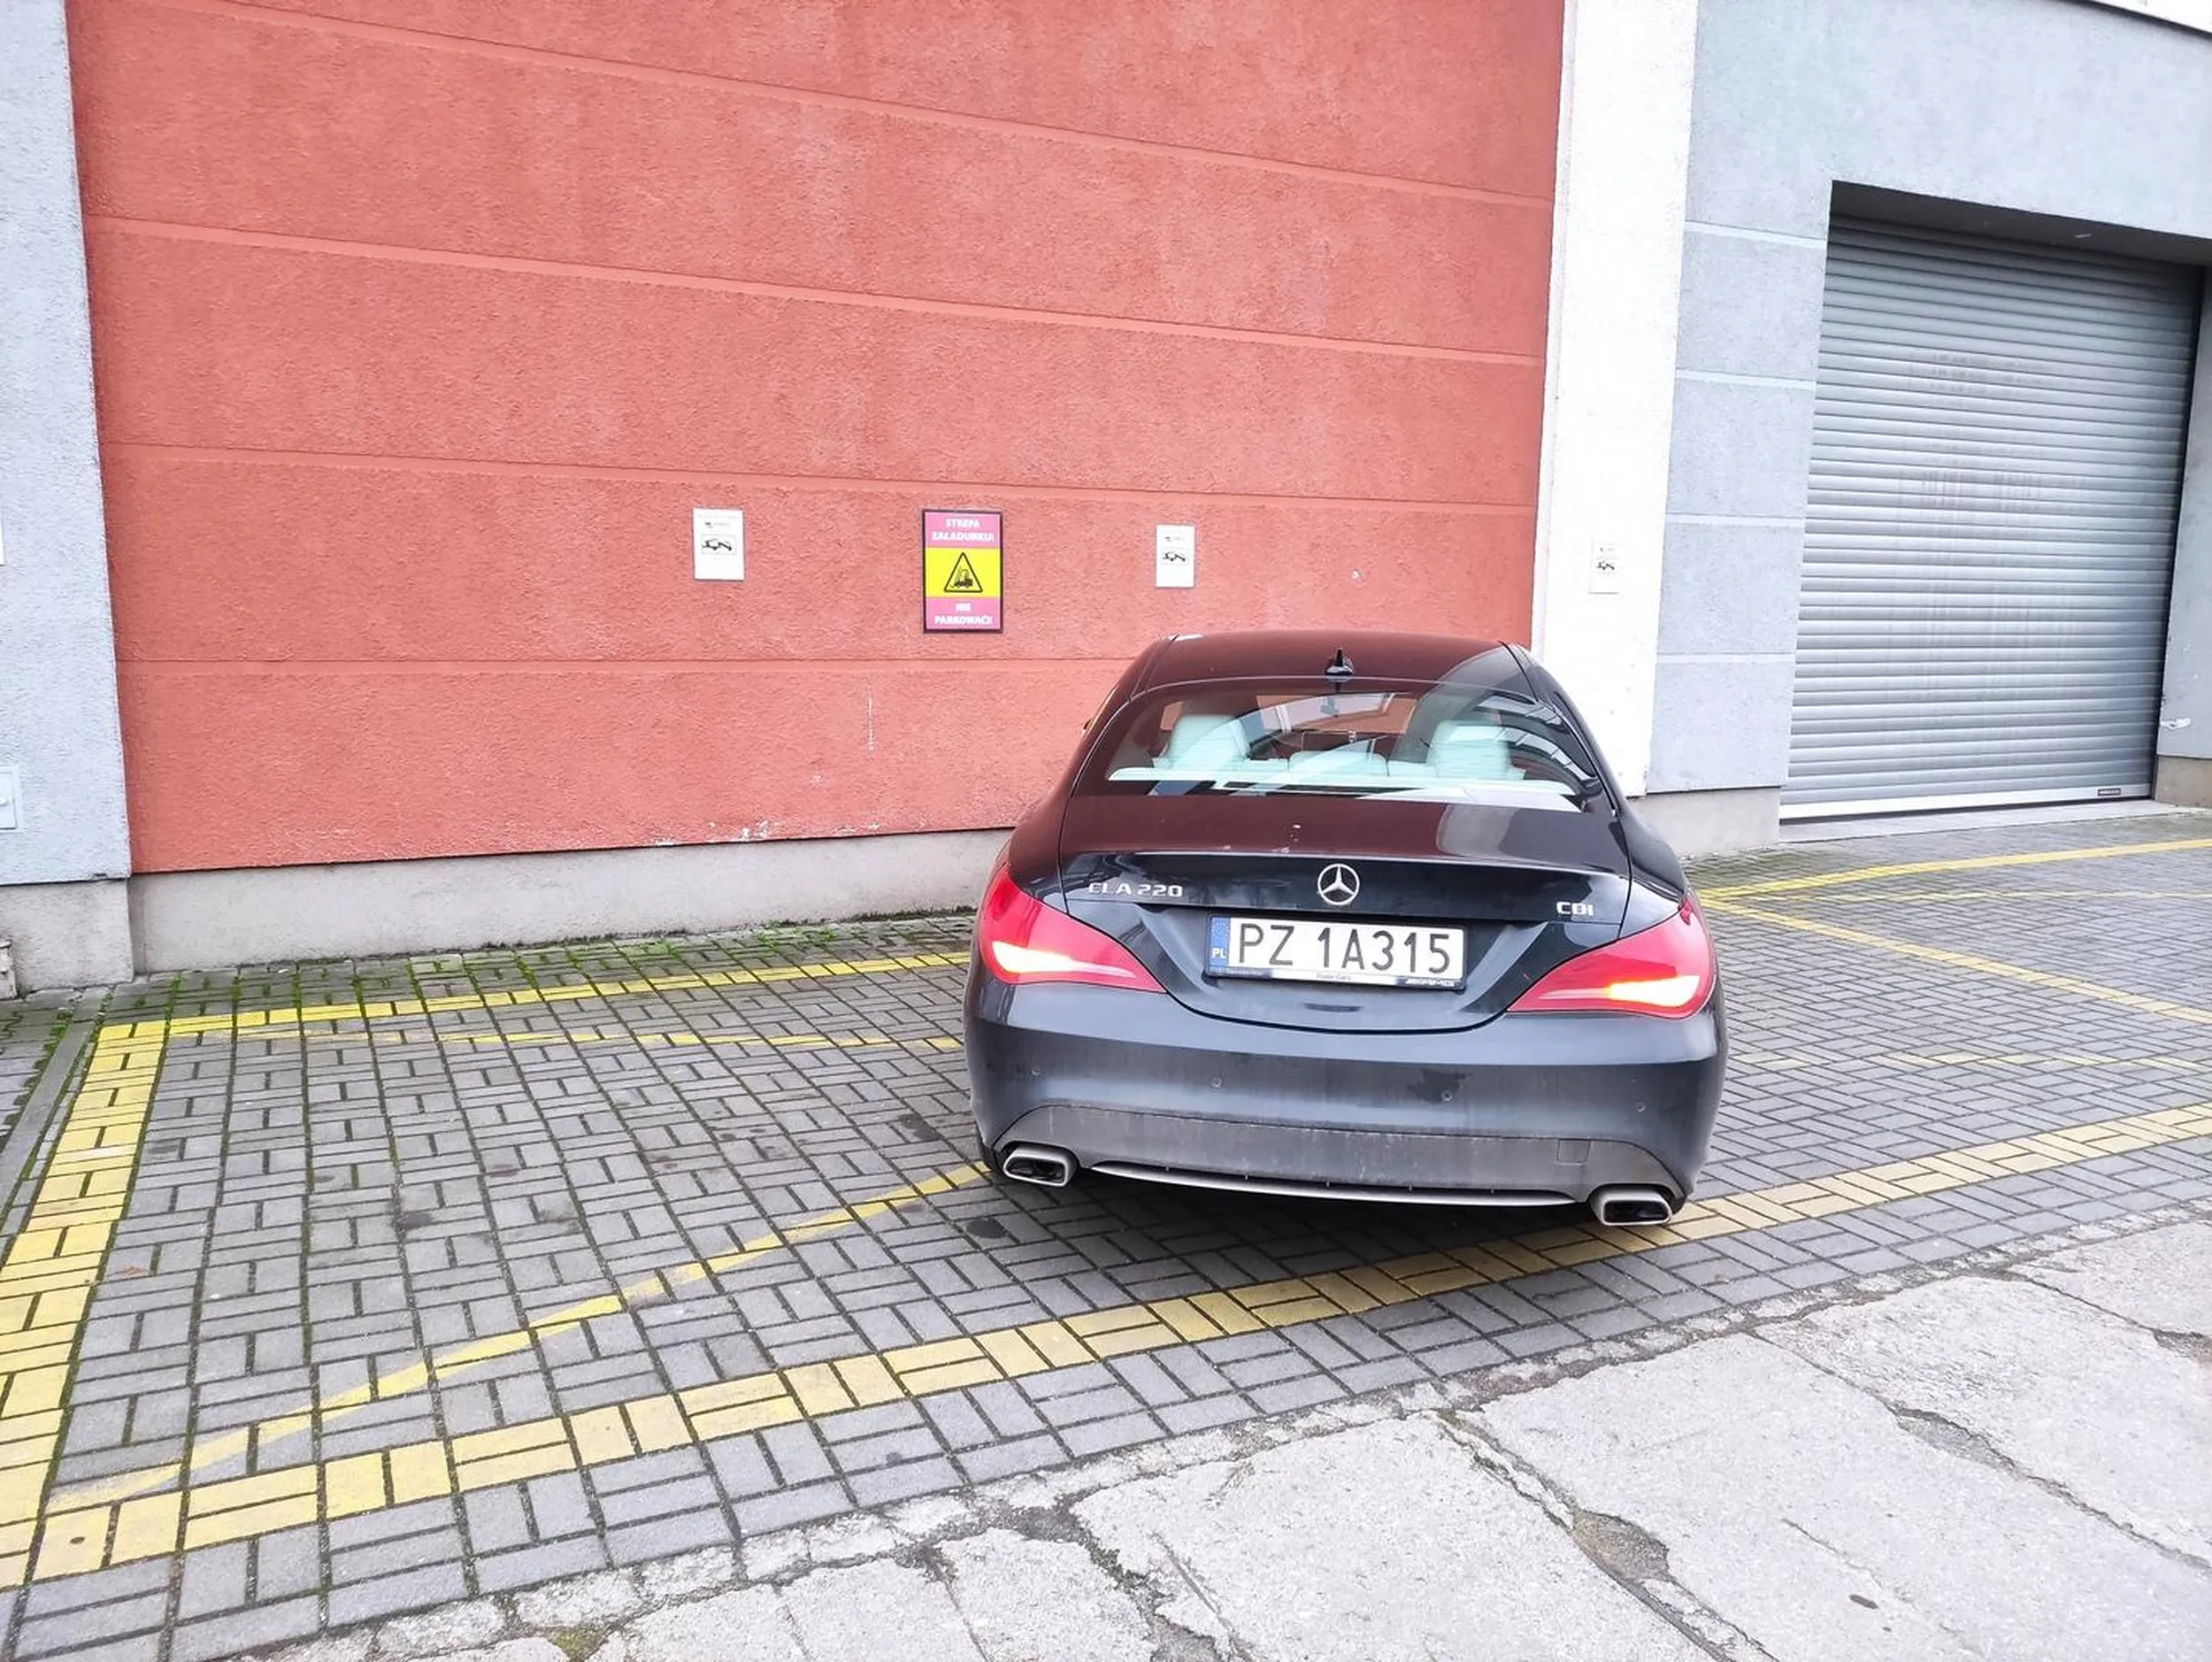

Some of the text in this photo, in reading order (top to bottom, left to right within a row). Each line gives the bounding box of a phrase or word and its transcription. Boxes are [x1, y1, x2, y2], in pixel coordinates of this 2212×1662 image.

[946, 519, 980, 528] STREFA
[1088, 882, 1183, 897] CLA 220
[1556, 901, 1594, 917] CDI
[1211, 947, 1227, 958] PL
[1239, 922, 1451, 974] PZ 1A315
